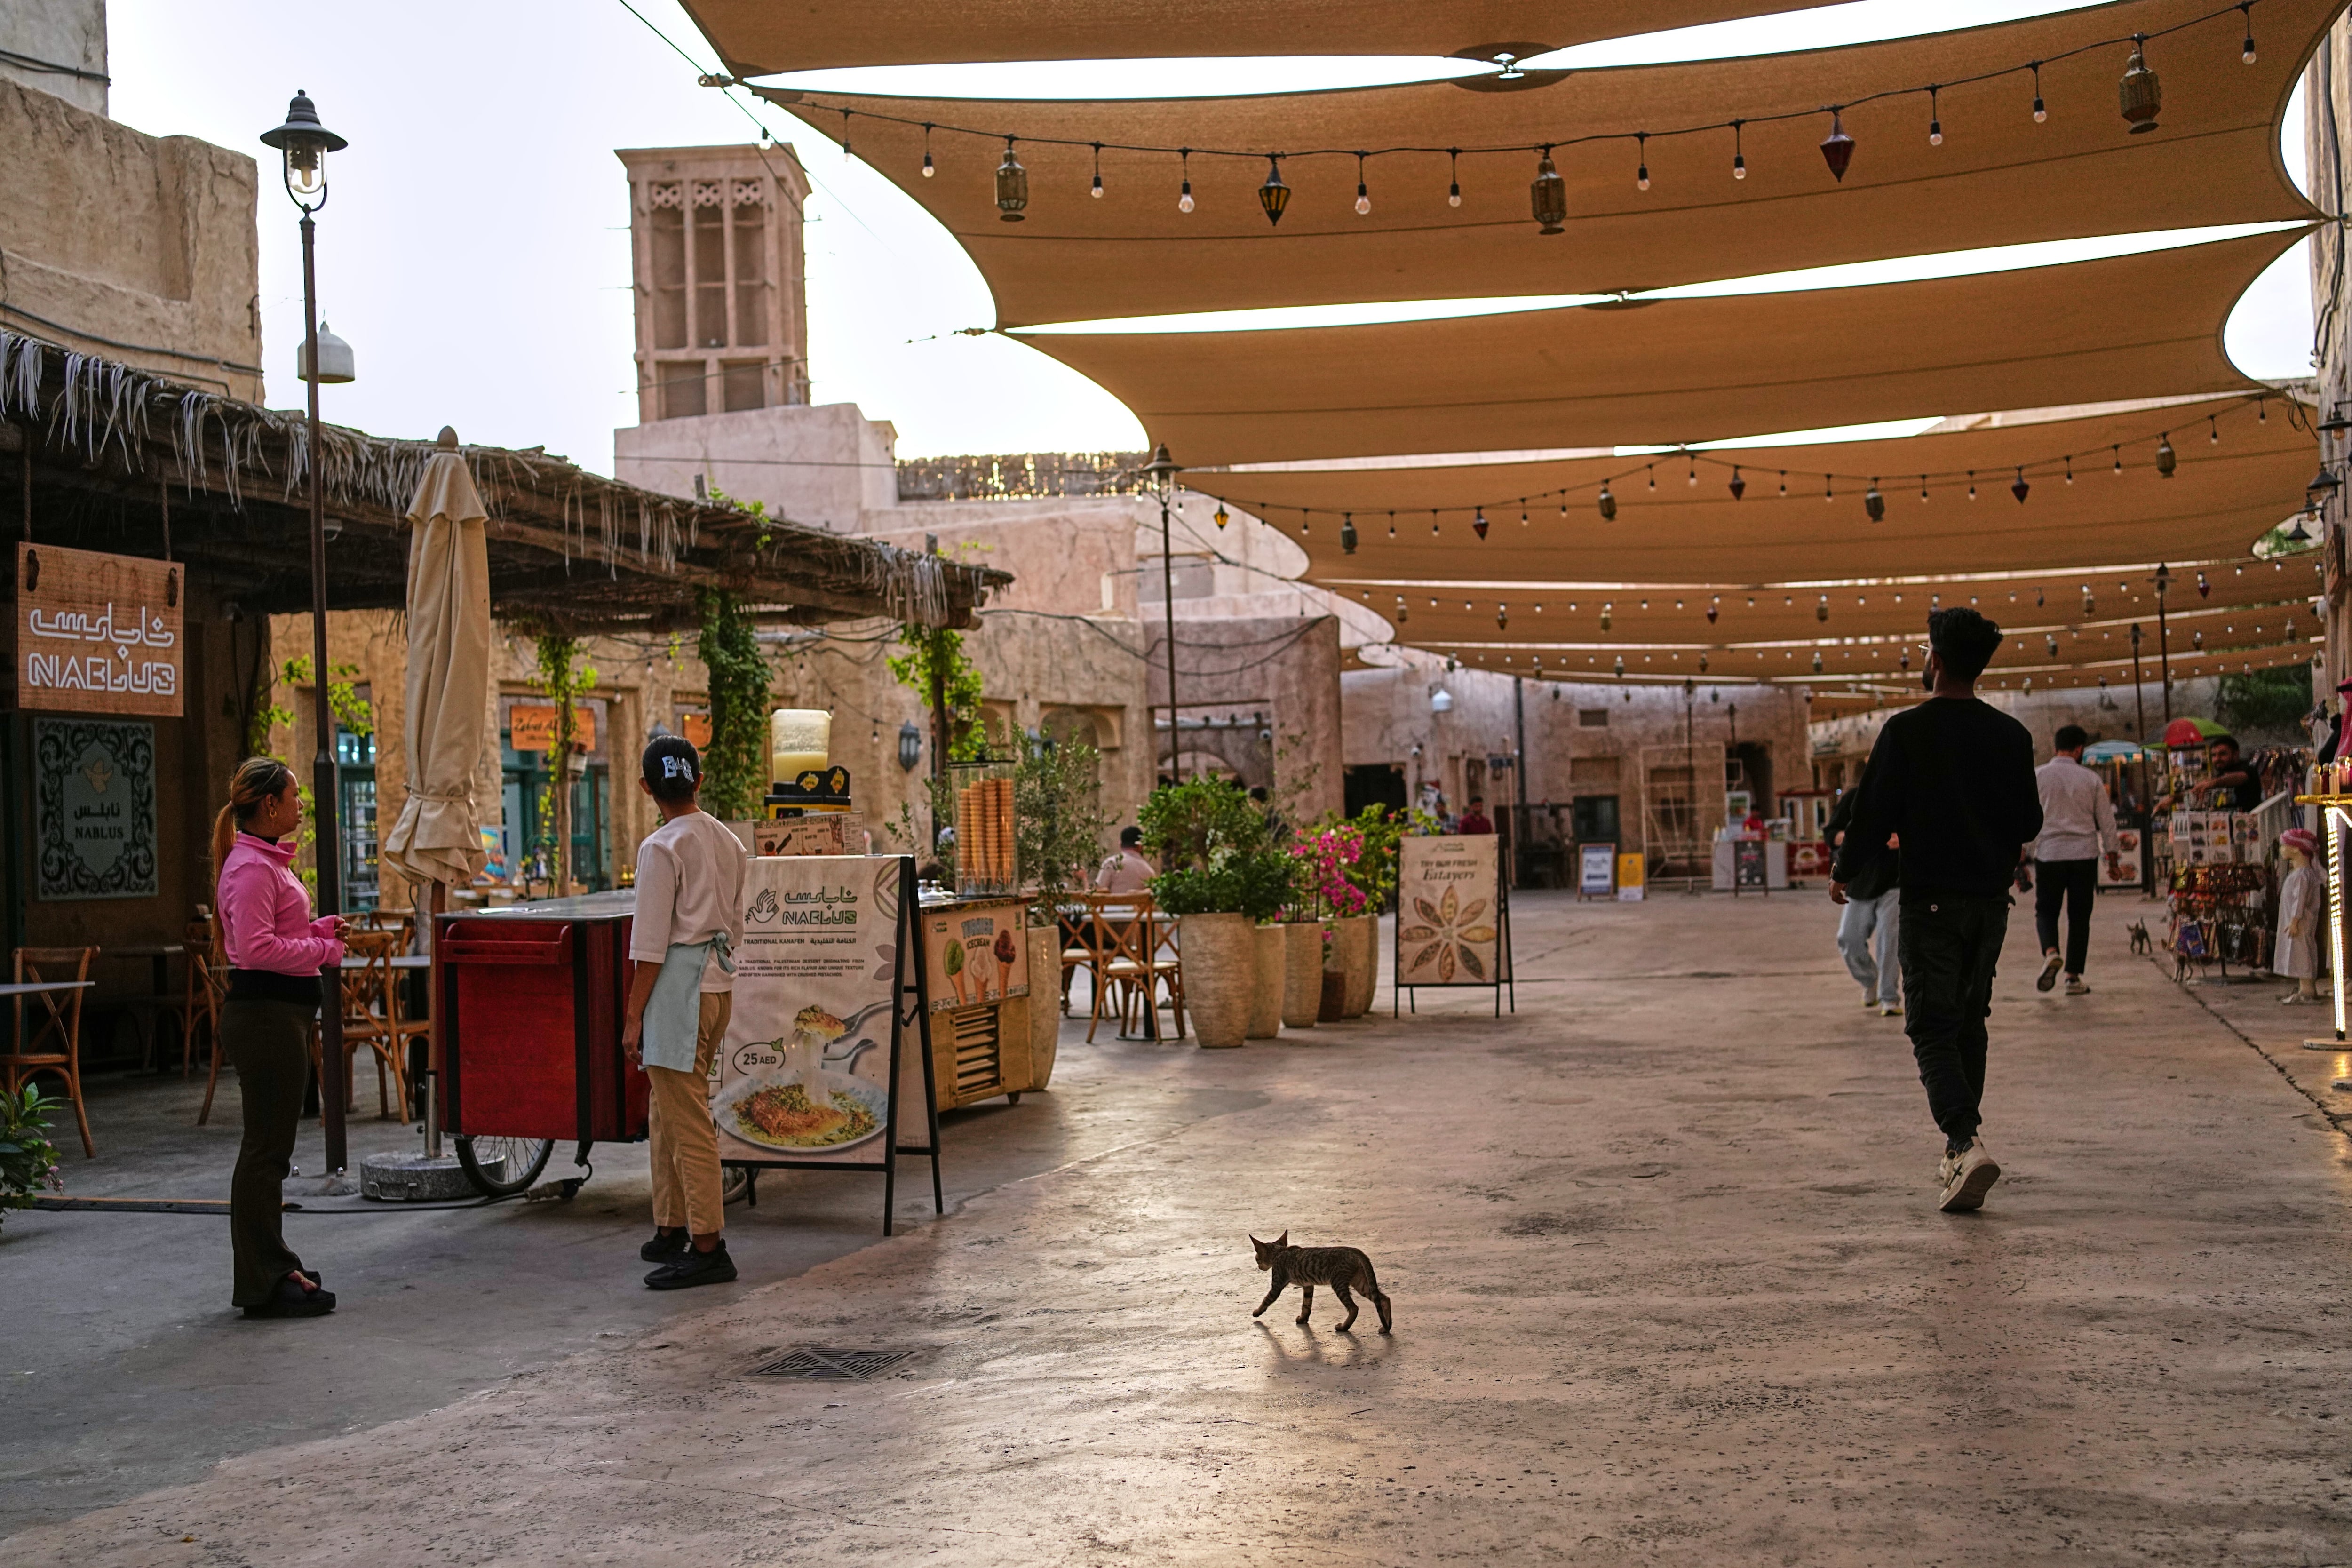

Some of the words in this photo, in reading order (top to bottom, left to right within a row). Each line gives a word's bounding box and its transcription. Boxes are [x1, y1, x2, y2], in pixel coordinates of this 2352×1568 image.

[29, 653, 175, 695] NABLUS
[74, 802, 120, 822] نابلس
[75, 826, 123, 839] NABLUS
[782, 910, 857, 925] NABLUS
[966, 938, 990, 950] ICECREAM
[743, 1053, 757, 1065] 25
